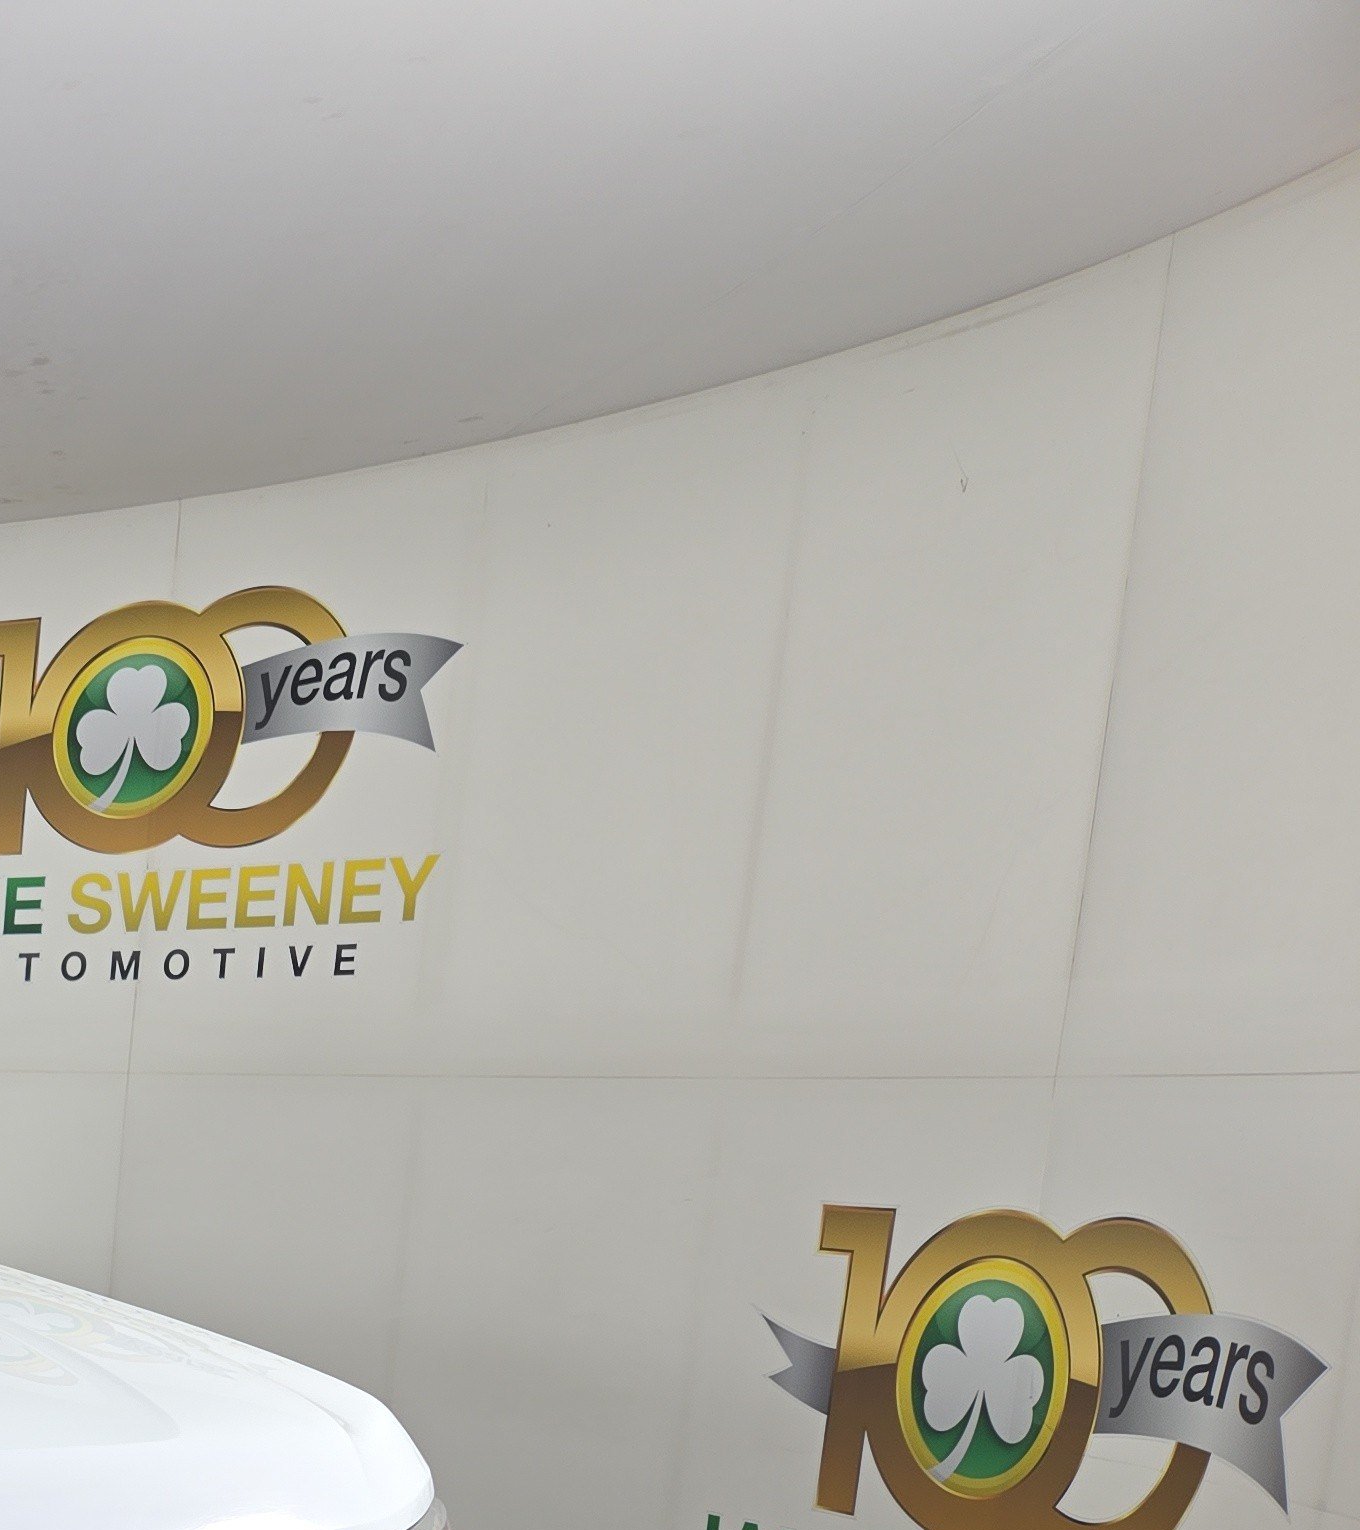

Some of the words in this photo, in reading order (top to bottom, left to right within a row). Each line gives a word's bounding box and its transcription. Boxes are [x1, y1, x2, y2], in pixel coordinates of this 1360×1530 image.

[254, 646, 412, 731] years
[67, 853, 441, 935] SWEENEY
[1108, 1332, 1276, 1426] years
